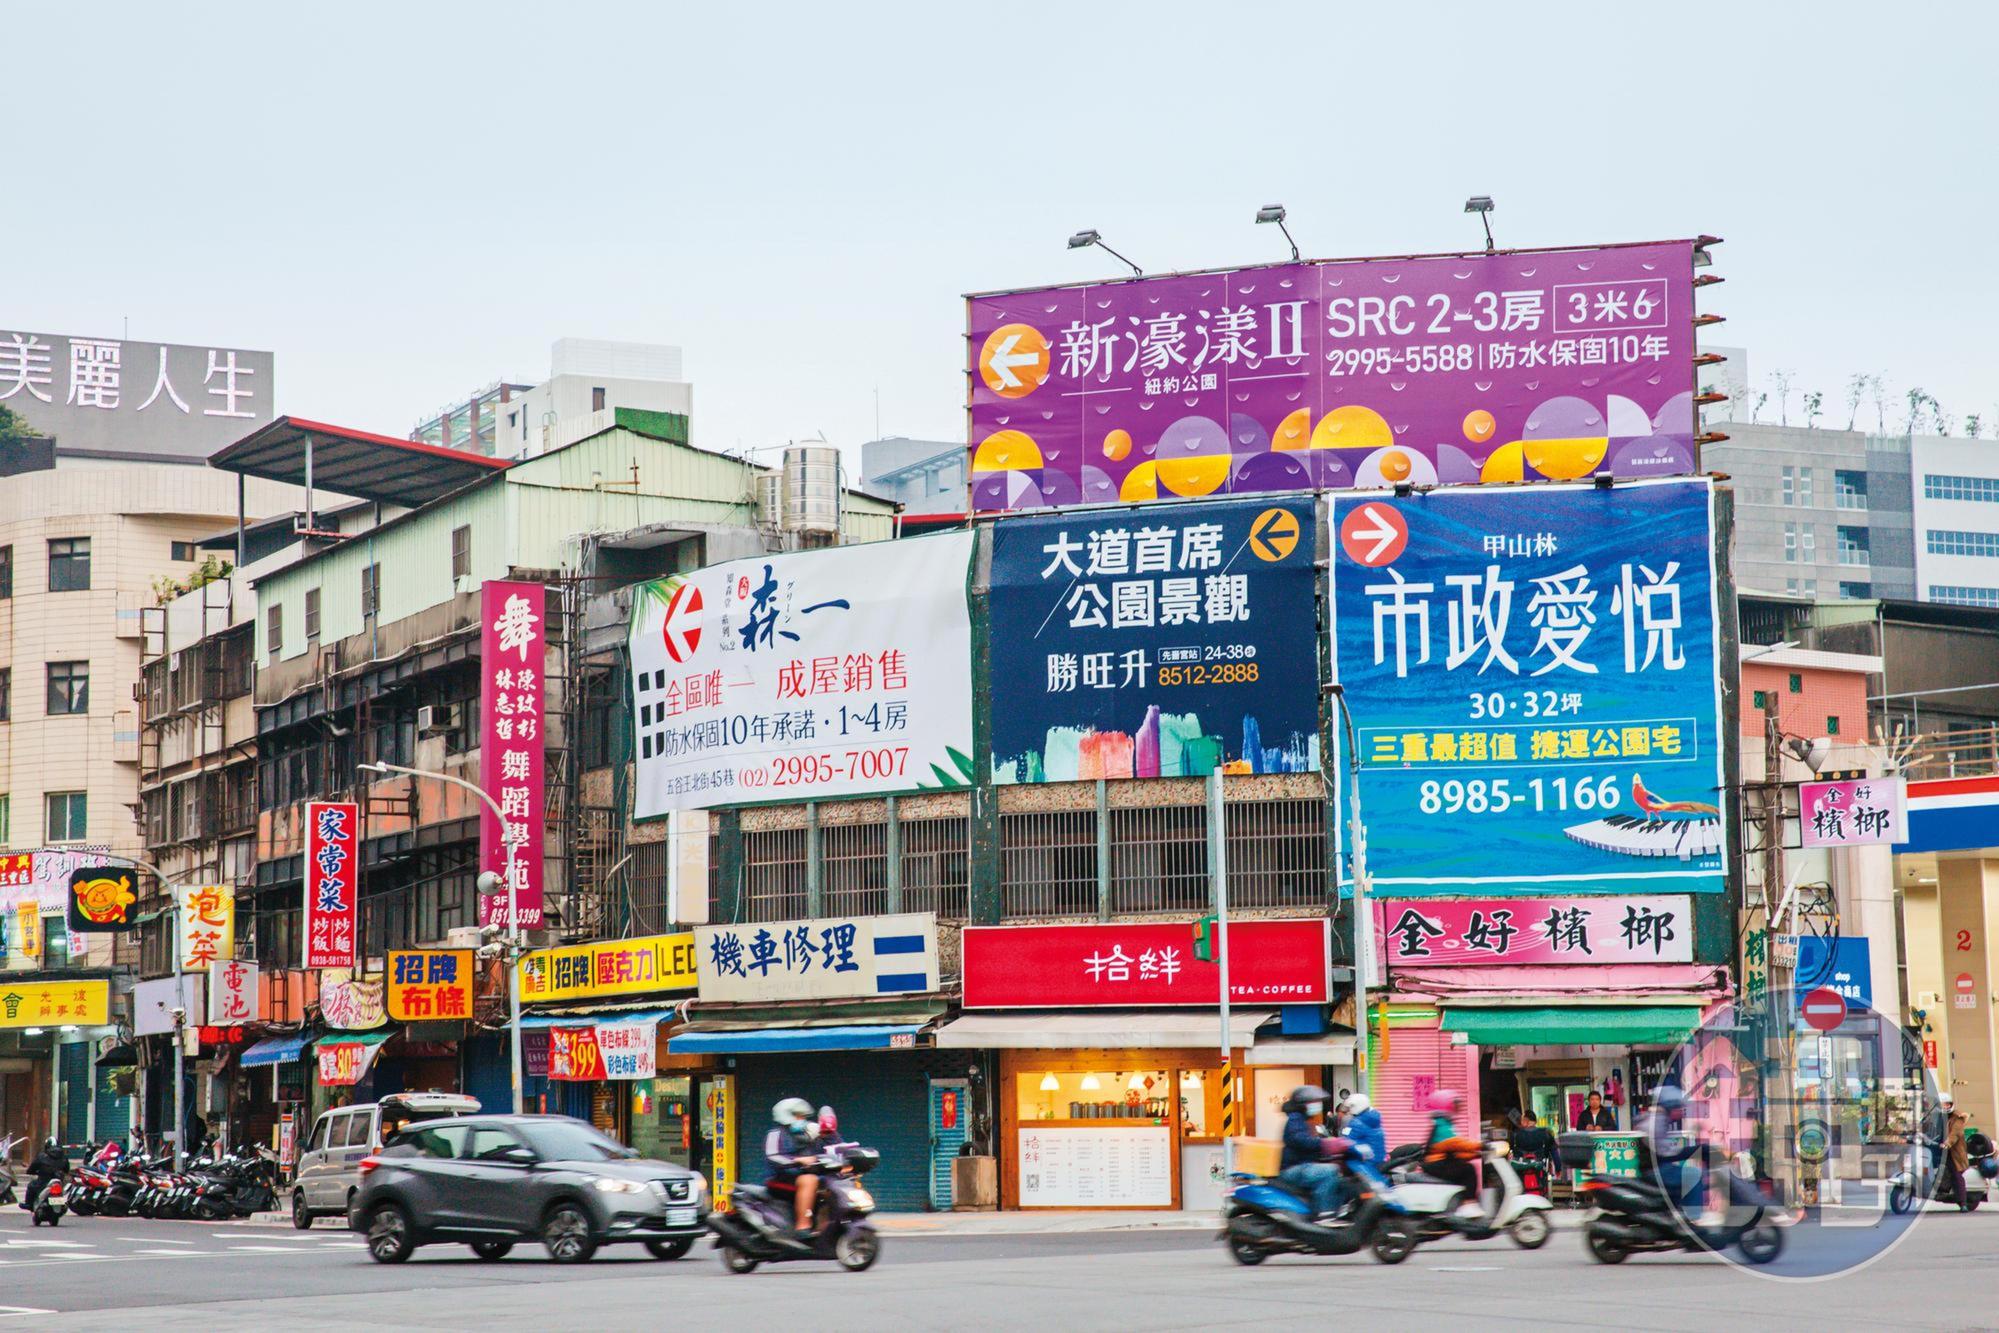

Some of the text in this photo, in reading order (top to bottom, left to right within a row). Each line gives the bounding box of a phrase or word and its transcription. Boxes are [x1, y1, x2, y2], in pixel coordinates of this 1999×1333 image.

[1328, 289, 1545, 338] SRC 2-3房
[1568, 288, 1653, 324] 3米6
[0, 334, 256, 418] 美麗人生
[1329, 333, 1670, 376] 2995-5588 防水保固10年
[1144, 374, 1218, 396] 紐約公園
[1041, 523, 1223, 579] 大道首席
[1483, 533, 1557, 559] 甲山林
[1066, 574, 1250, 629] 公園景觀
[493, 593, 539, 662] 舞
[776, 649, 908, 700] 成屋銷售
[1046, 649, 1152, 692] 勝旺升
[1158, 662, 1259, 686] 8512-2888
[665, 669, 755, 717] 全區唯一
[1372, 726, 1682, 763] 三重最超值 捷運公園宅
[772, 747, 909, 786] 2995-7007
[1419, 775, 1621, 814] 8985-1166
[316, 809, 349, 914] 家常菜
[186, 887, 226, 967] 泡菜
[1389, 905, 1675, 956] 金好檳榔
[1956, 929, 1972, 952] 2
[395, 954, 457, 985] 招牌
[555, 954, 589, 990] 招牌
[710, 923, 860, 978] 機車修理
[223, 963, 250, 1019] 電池
[402, 986, 465, 1017] 布條
